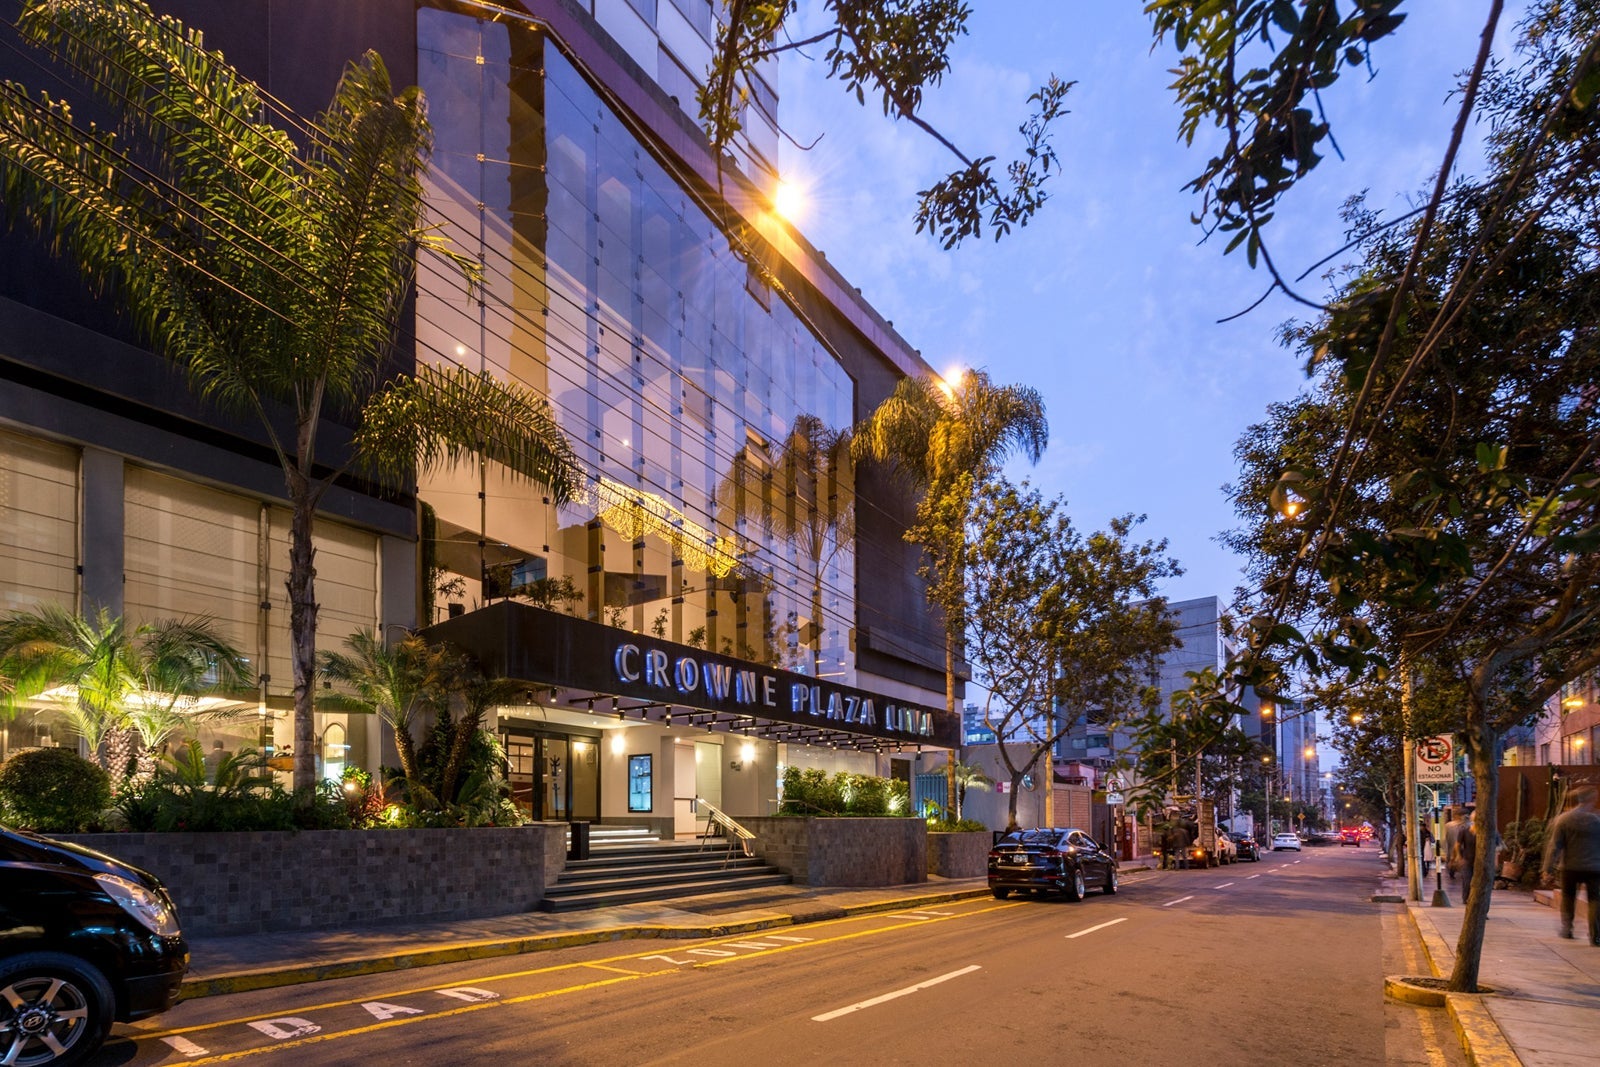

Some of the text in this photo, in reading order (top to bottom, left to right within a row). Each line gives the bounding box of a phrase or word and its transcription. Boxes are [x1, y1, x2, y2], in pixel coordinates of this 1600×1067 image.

[615, 644, 934, 736] CROWNE PLAZA LIMA
